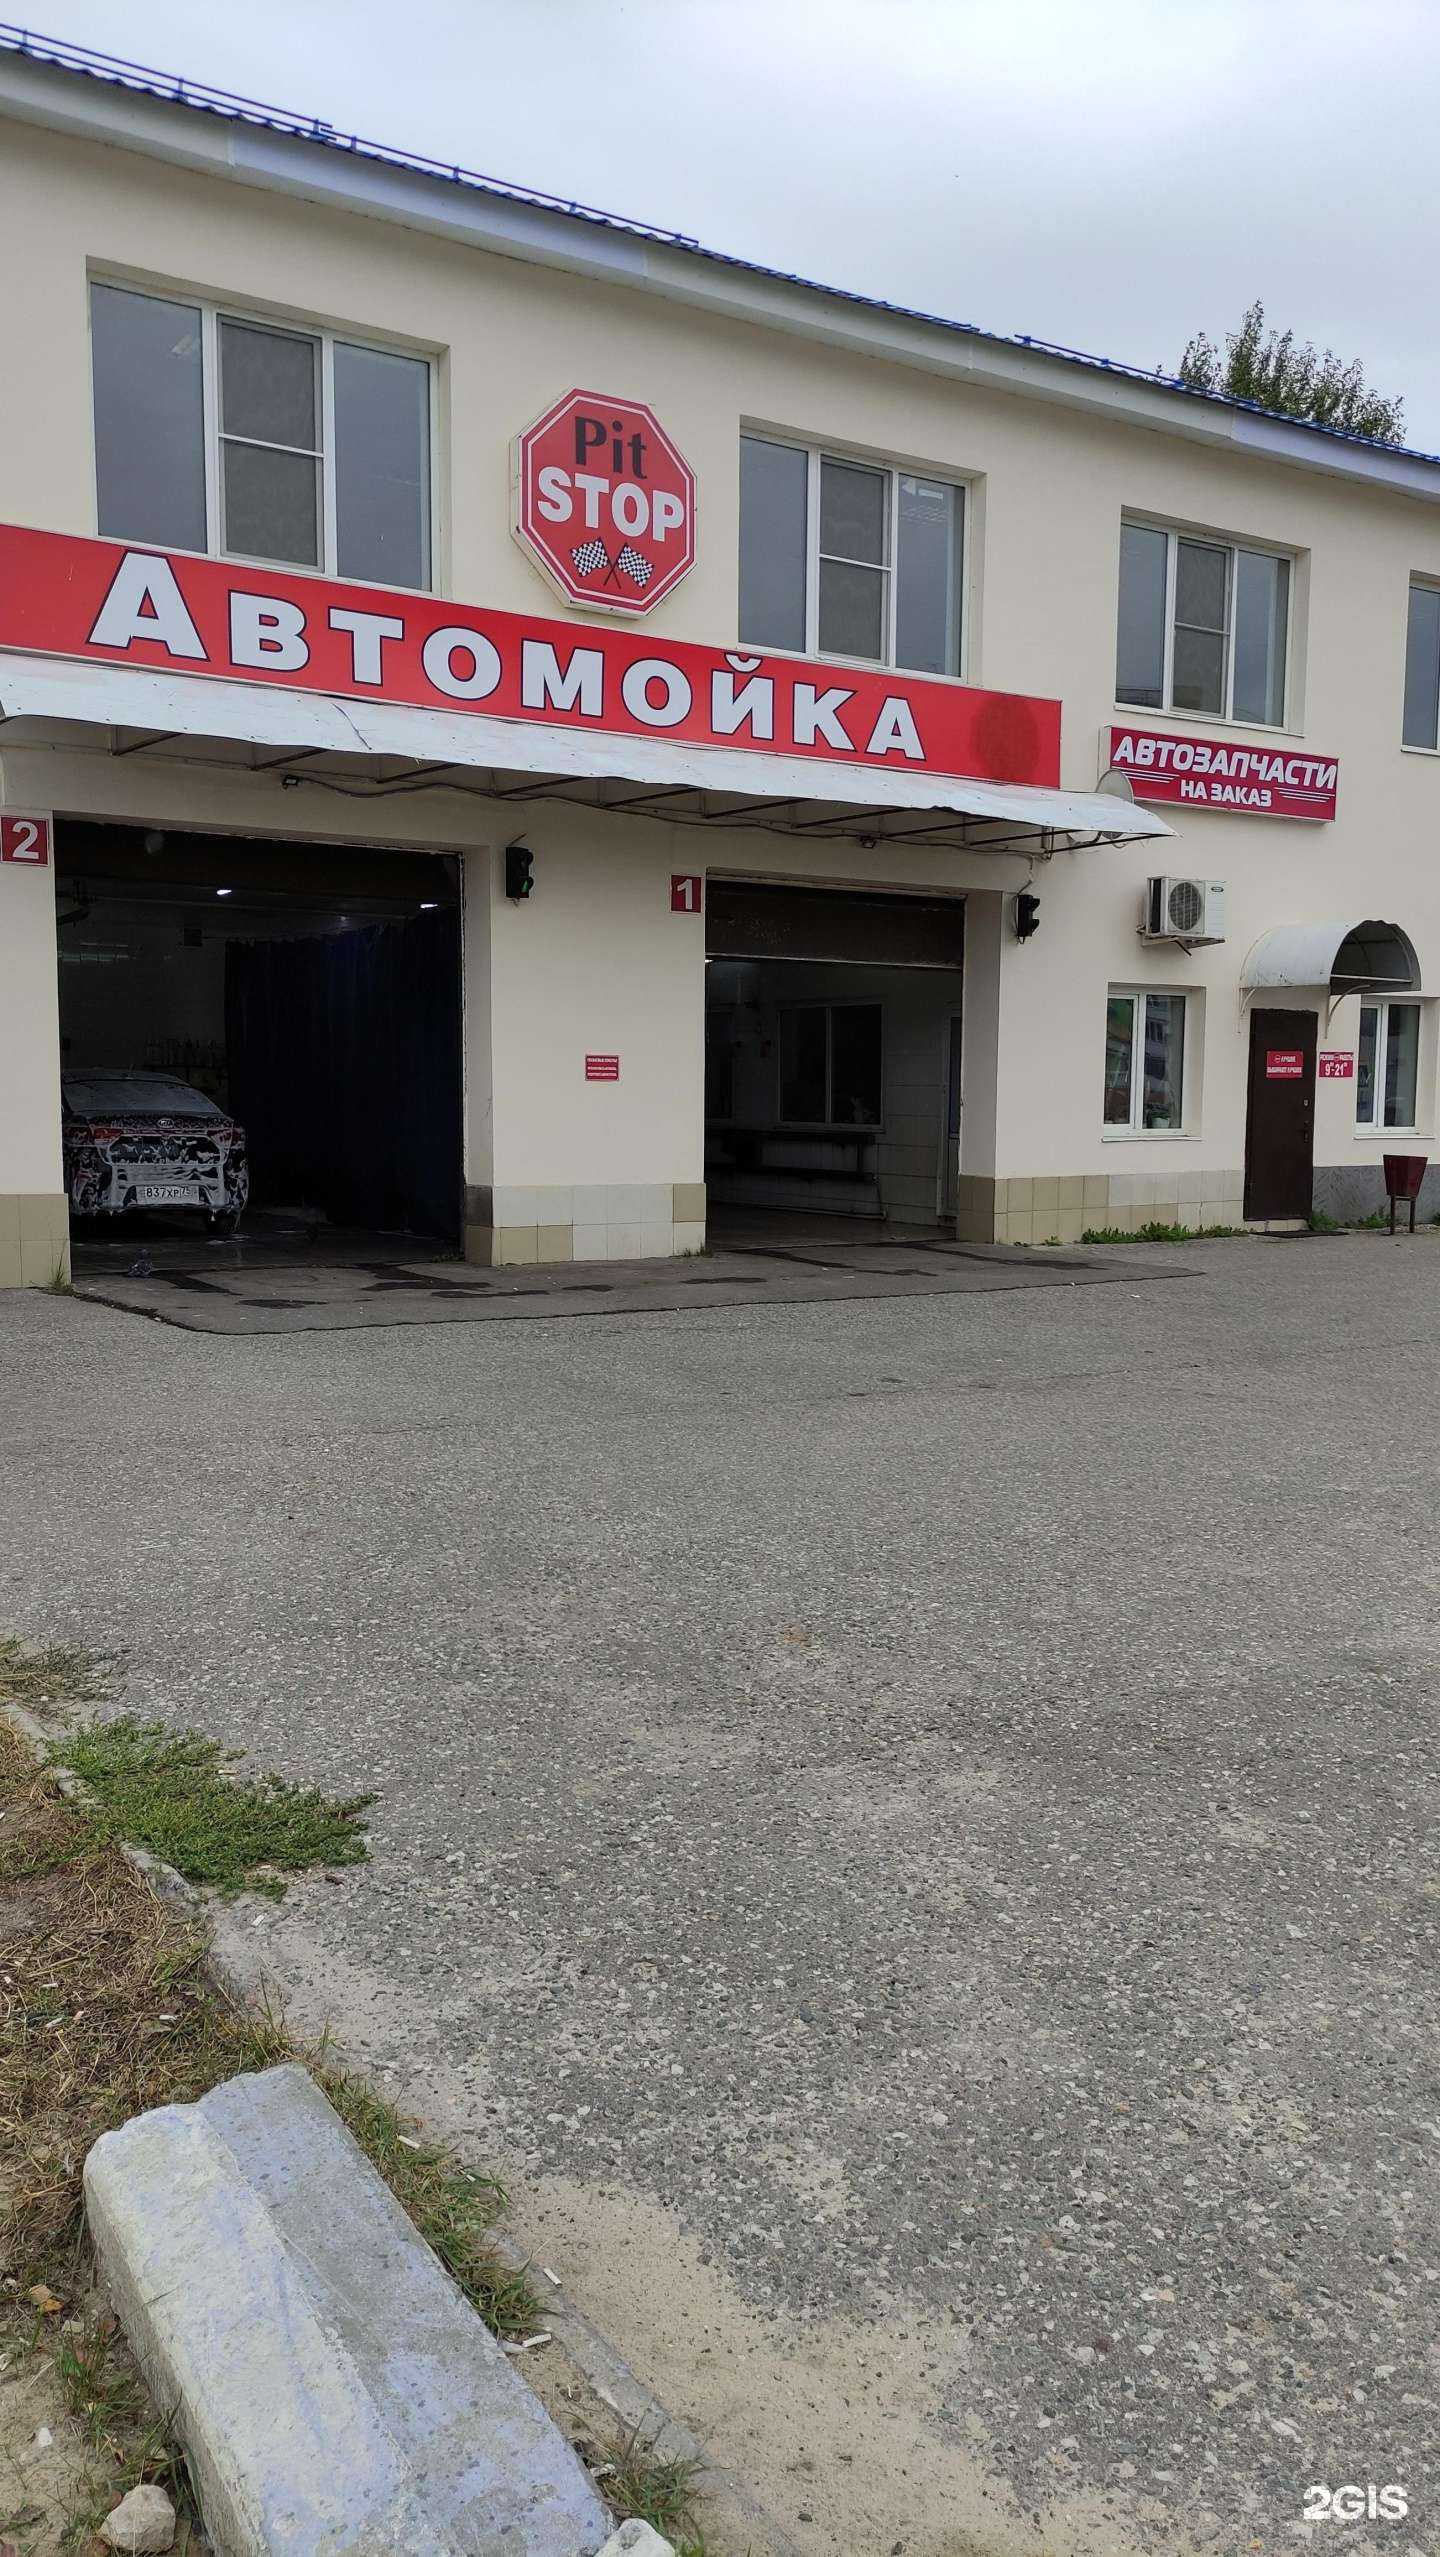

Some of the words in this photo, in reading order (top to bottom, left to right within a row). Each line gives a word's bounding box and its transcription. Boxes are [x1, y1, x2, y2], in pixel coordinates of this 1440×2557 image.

[575, 416, 647, 479] Pit
[537, 466, 685, 542] STOP
[1112, 735, 1338, 790] АВТОЗАПЧАСТИ
[1180, 779, 1208, 800] НА
[1210, 783, 1272, 807] ЗАКАЗ
[12, 821, 40, 860] 2
[677, 879, 693, 910] 1
